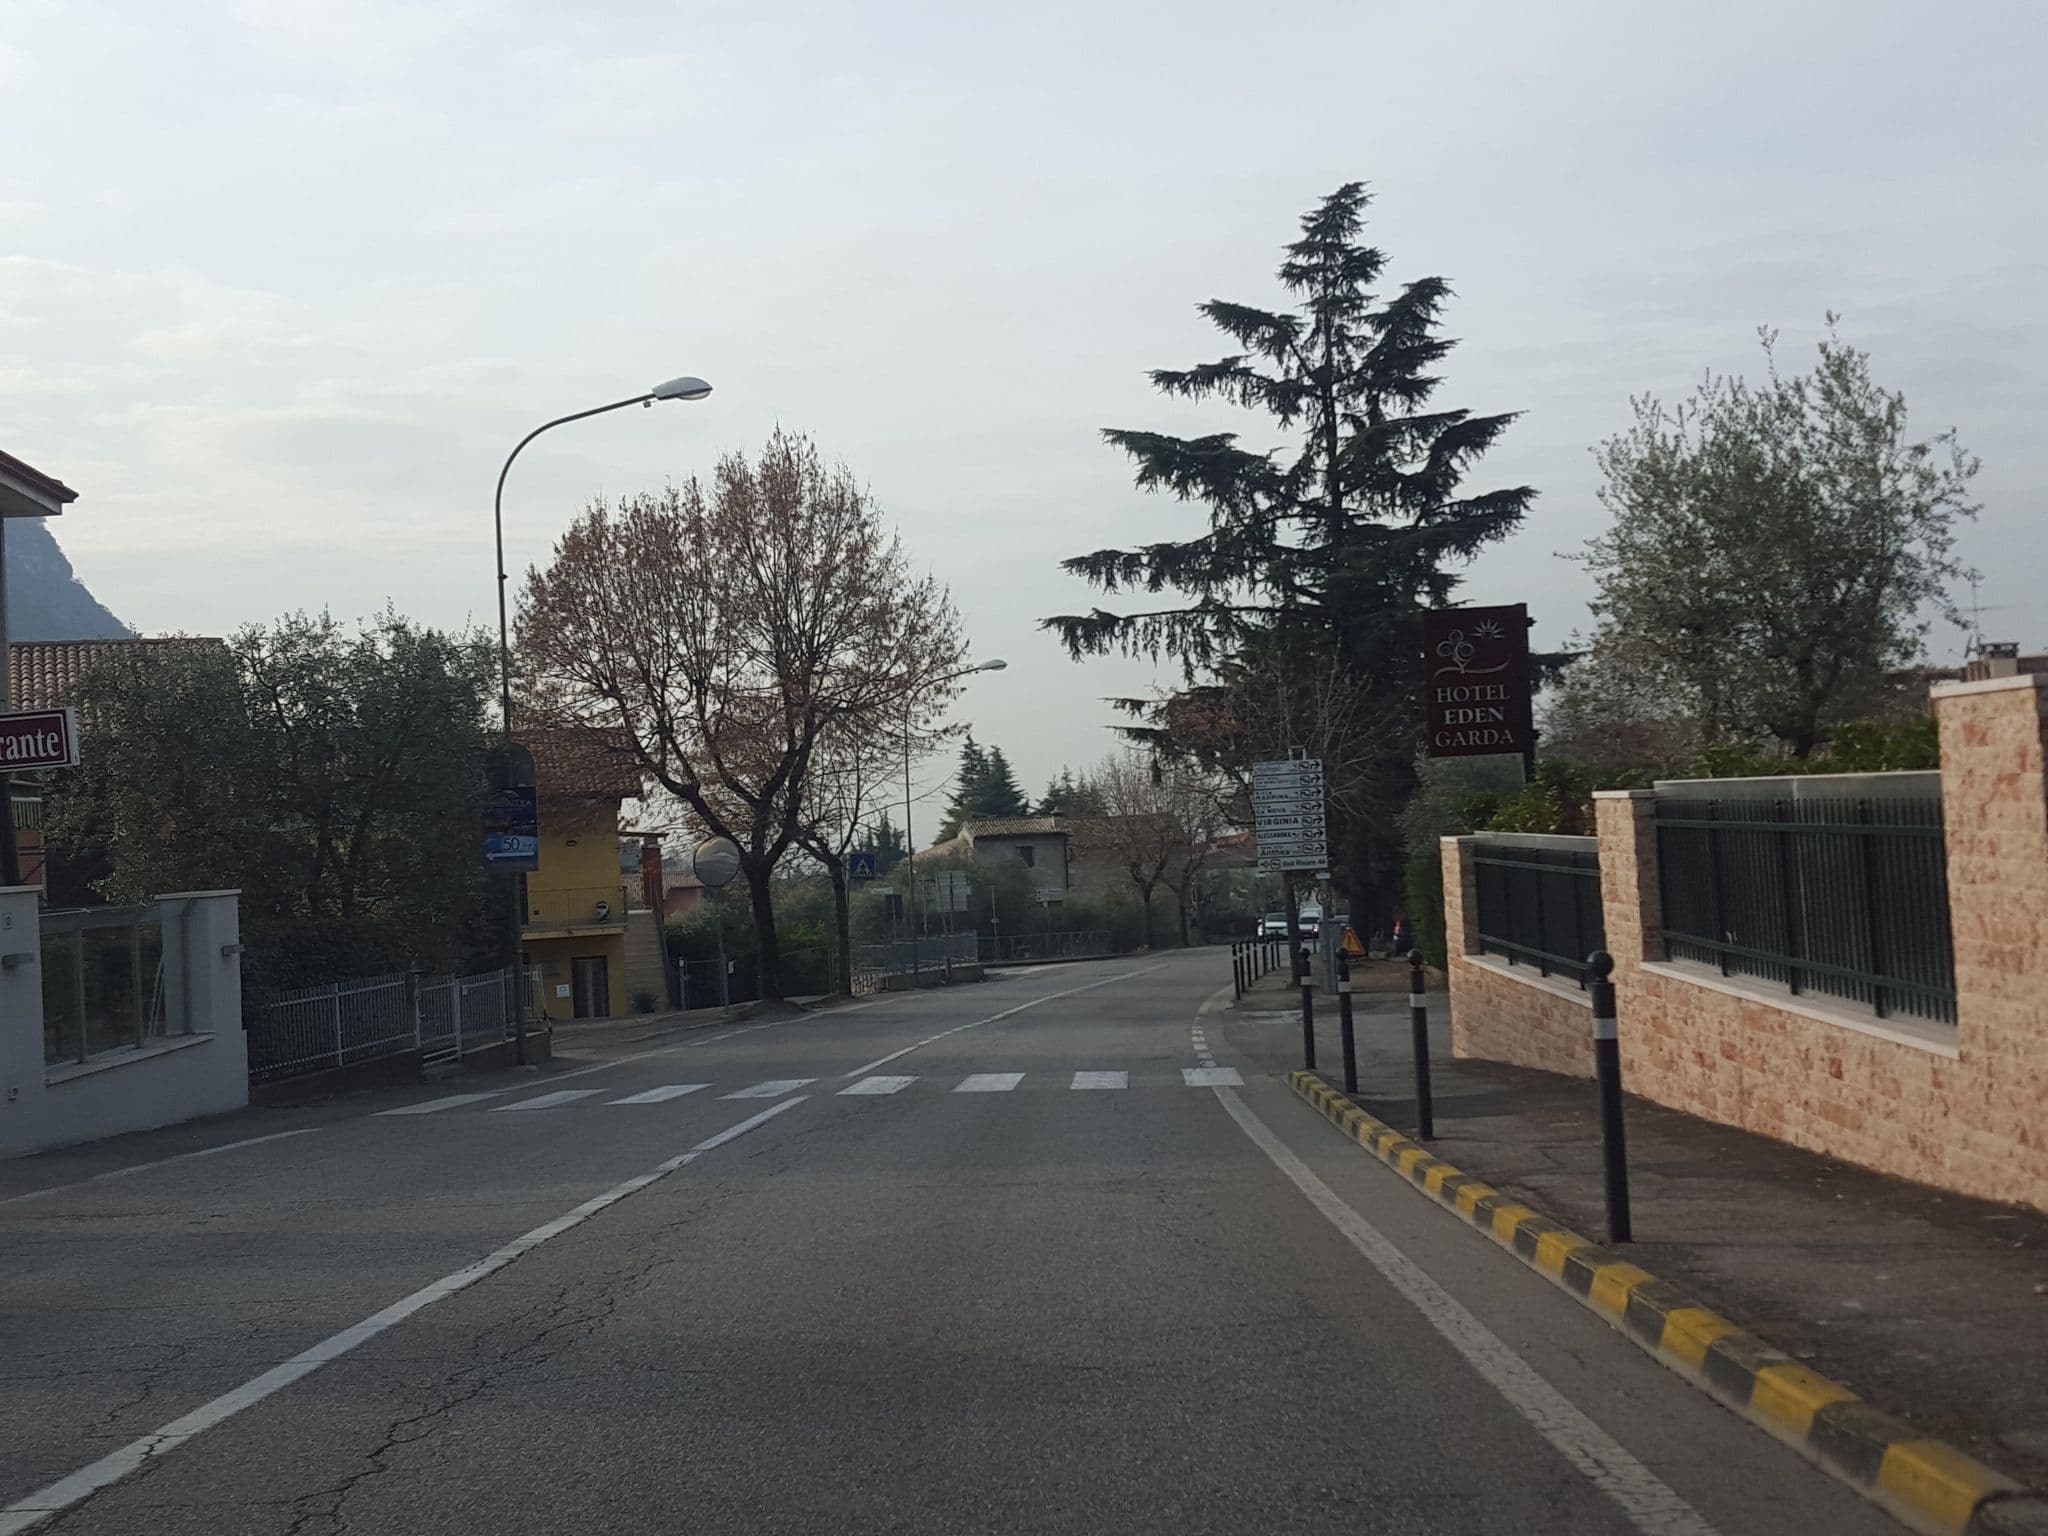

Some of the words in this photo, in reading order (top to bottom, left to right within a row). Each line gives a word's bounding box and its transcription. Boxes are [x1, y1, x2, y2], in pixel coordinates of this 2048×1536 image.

[1437, 684, 1510, 703] HOTEL
[1444, 706, 1504, 725] EDEN
[1435, 729, 1514, 747] GARDA
[1257, 817, 1299, 826] VIRGINIA
[503, 838, 520, 851] 50
